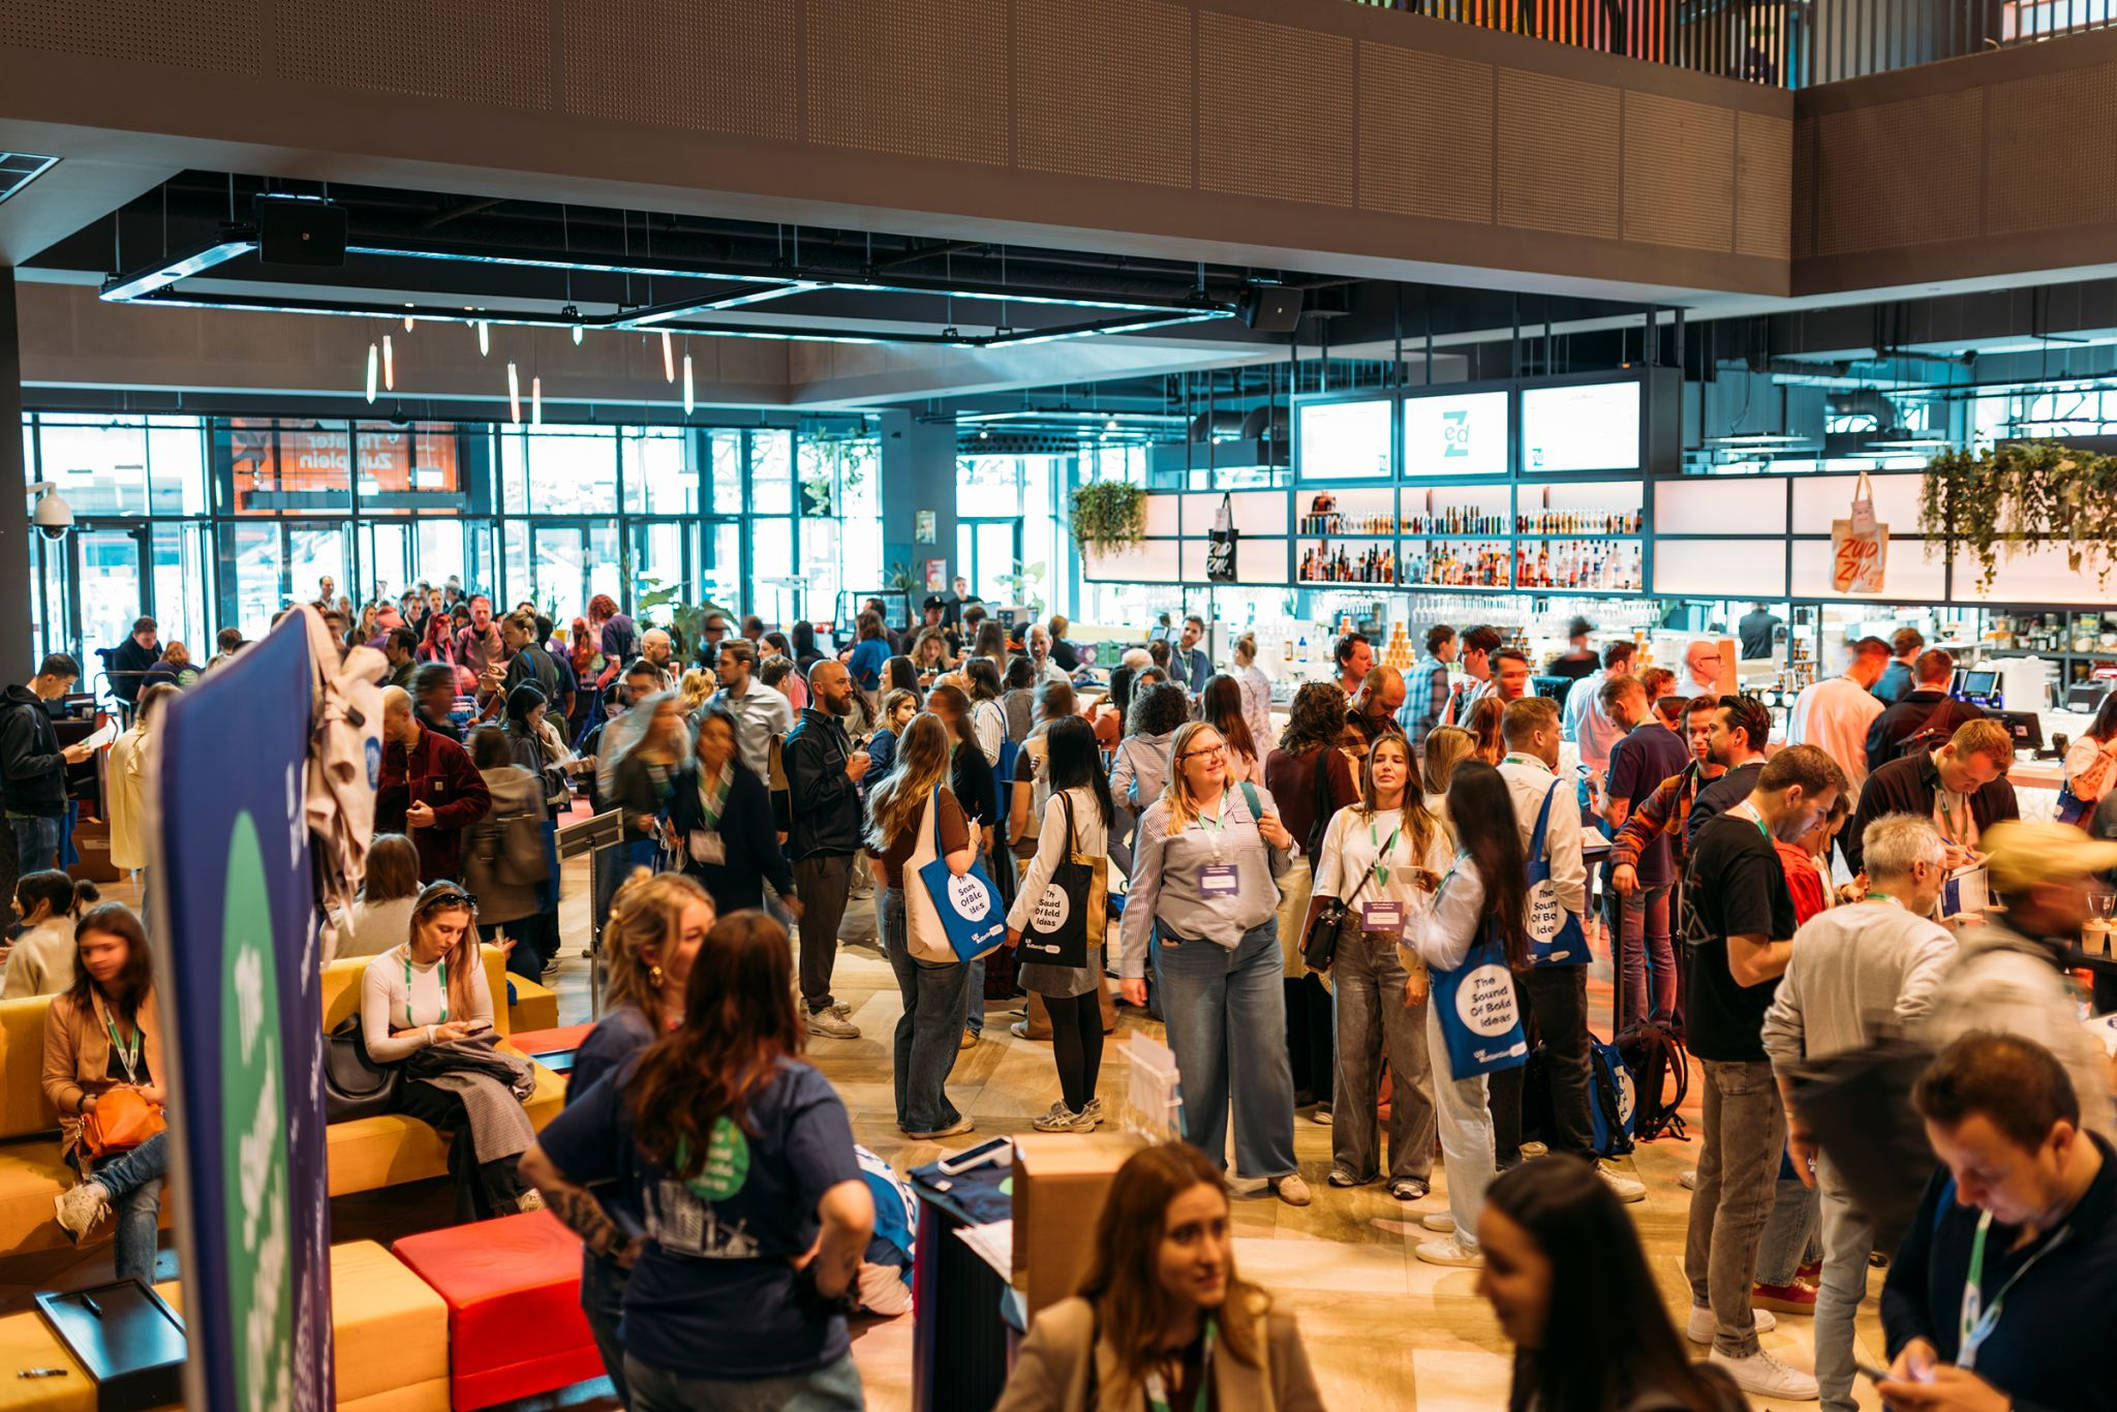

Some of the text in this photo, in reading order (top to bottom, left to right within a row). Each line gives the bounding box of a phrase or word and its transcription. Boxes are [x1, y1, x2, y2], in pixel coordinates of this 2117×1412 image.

[1534, 900, 1557, 911] Soun
[1531, 912, 1557, 923] Of Bo
[1536, 925, 1554, 935] Ide
[1474, 977, 1496, 989] The
[1472, 986, 1508, 1003] Sound
[1470, 999, 1512, 1017] Of Bold
